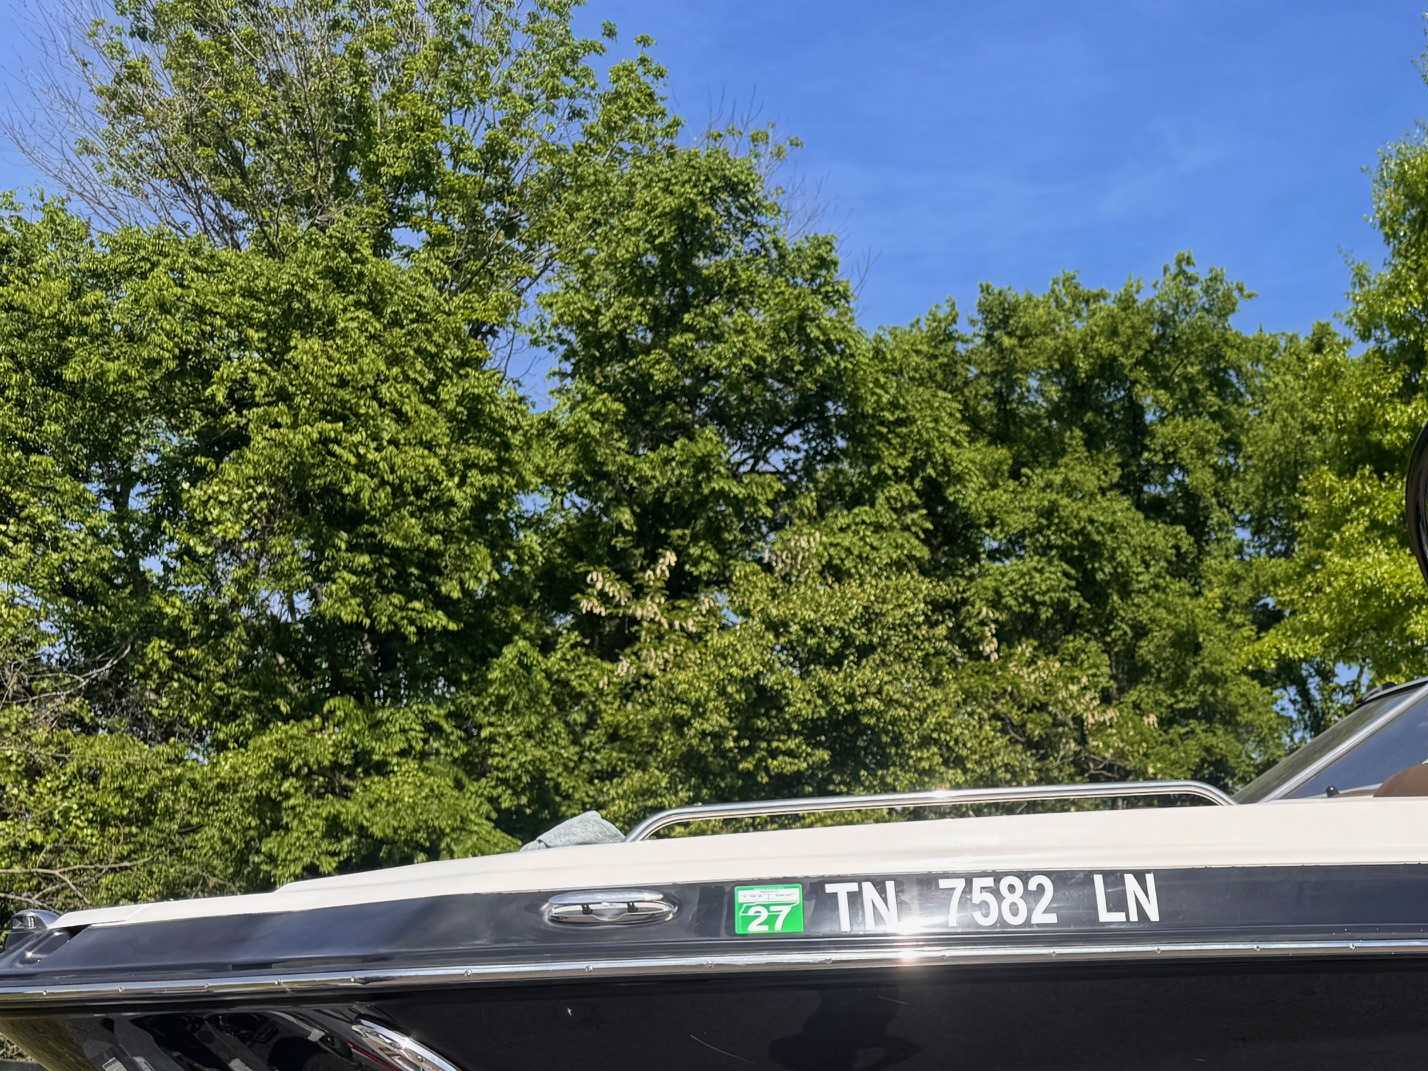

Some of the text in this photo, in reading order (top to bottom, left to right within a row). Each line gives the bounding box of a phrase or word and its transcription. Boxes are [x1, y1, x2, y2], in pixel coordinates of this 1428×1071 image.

[747, 904, 793, 932] 27
[824, 872, 1160, 932] TN 7582 LN
